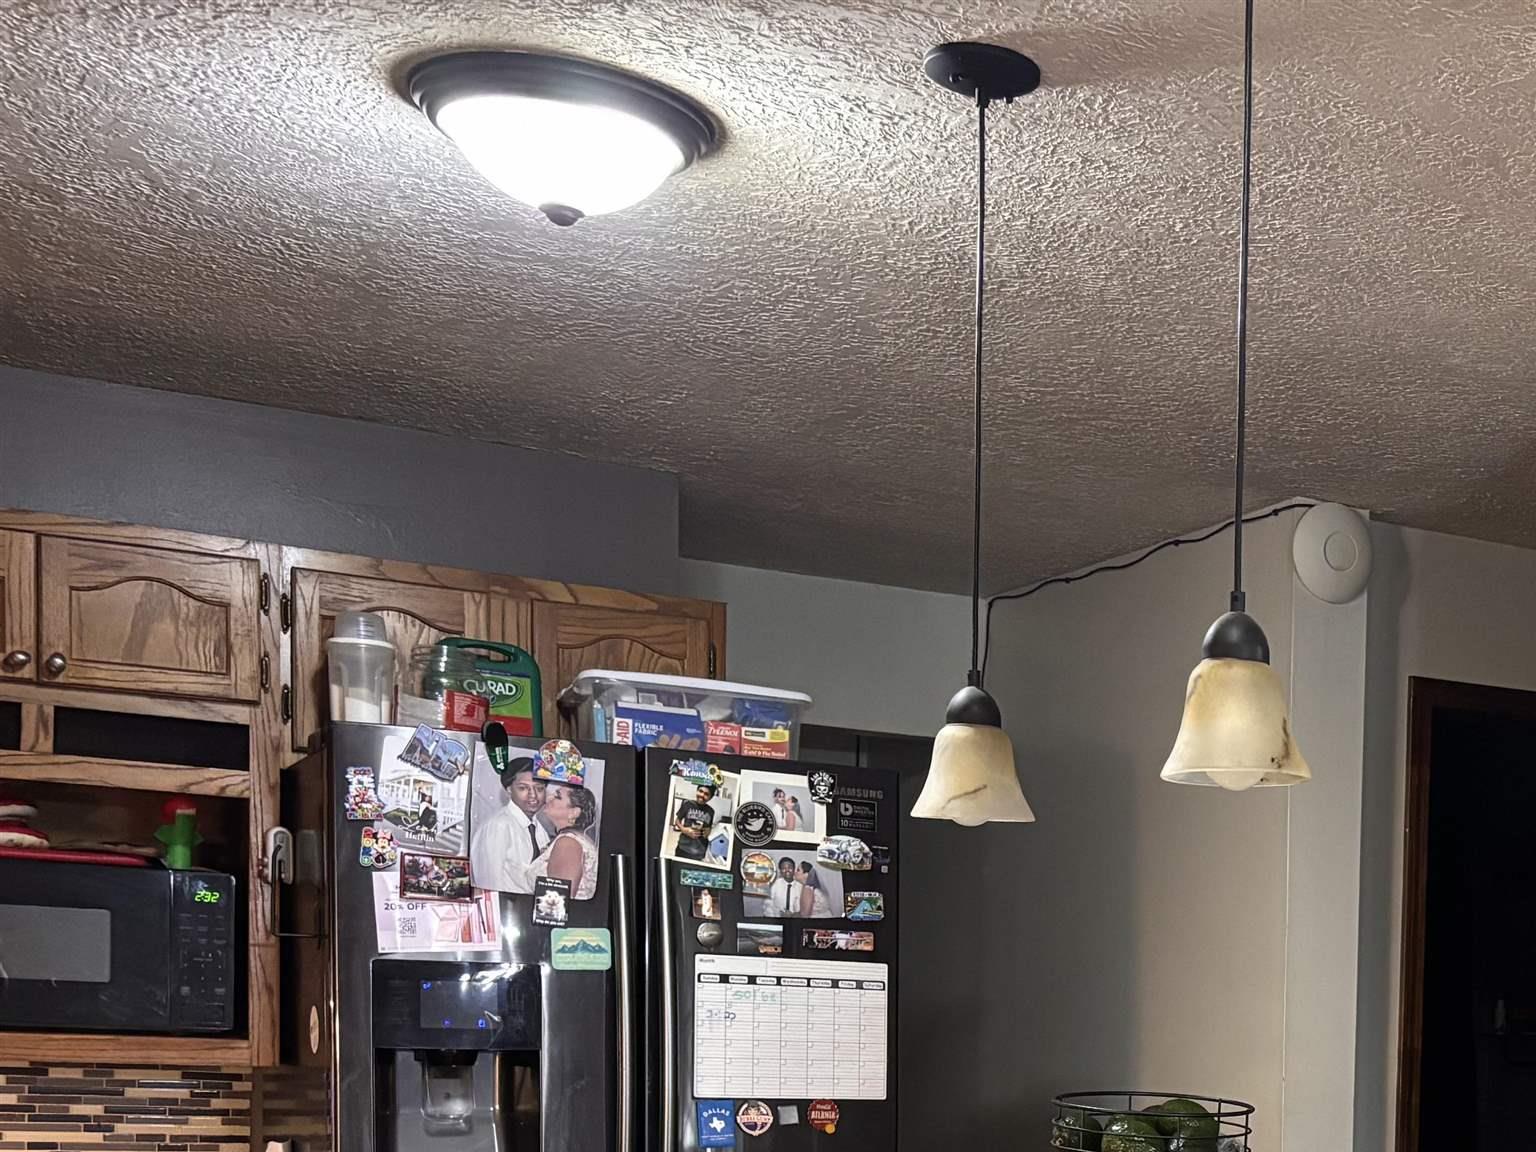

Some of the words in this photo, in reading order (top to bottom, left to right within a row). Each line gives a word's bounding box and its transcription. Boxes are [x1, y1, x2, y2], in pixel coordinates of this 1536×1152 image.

[463, 679, 516, 697] CURAD
[634, 728, 658, 737] FABRIC
[407, 902, 427, 911] OFF
